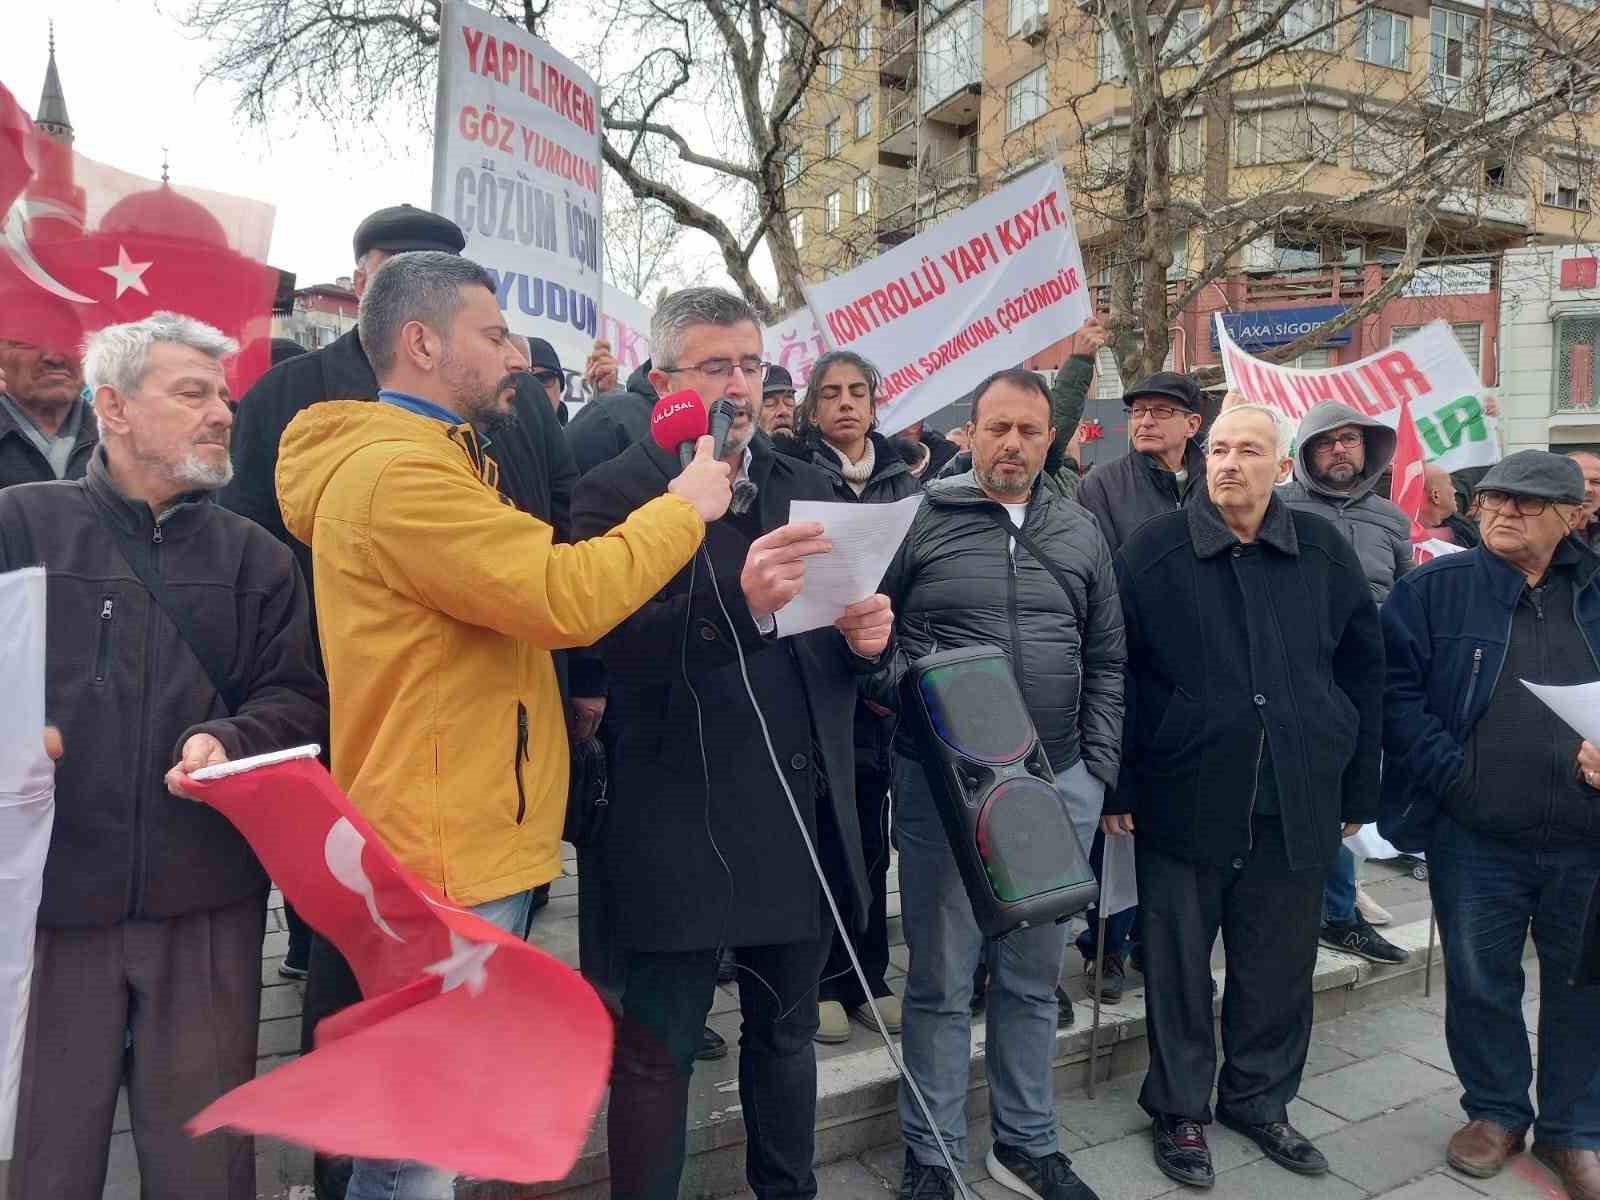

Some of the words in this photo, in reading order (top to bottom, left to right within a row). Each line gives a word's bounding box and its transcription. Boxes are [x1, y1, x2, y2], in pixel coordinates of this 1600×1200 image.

[462, 26, 595, 136] YAPILIRKEN
[458, 104, 515, 155] GÖZ
[521, 125, 597, 194] YUMDUN
[455, 158, 558, 254] ÇÖZÜM
[563, 188, 597, 275] İÇİN
[486, 267, 598, 339] YUDUN
[825, 255, 947, 347] KONTROLLÜ
[941, 232, 999, 284] YAPI
[917, 315, 999, 376] SORUNUNA
[996, 266, 1081, 335] ÇÖZÜMDÜR
[1240, 326, 1272, 338] AXA
[652, 400, 695, 424] ULUSAL
